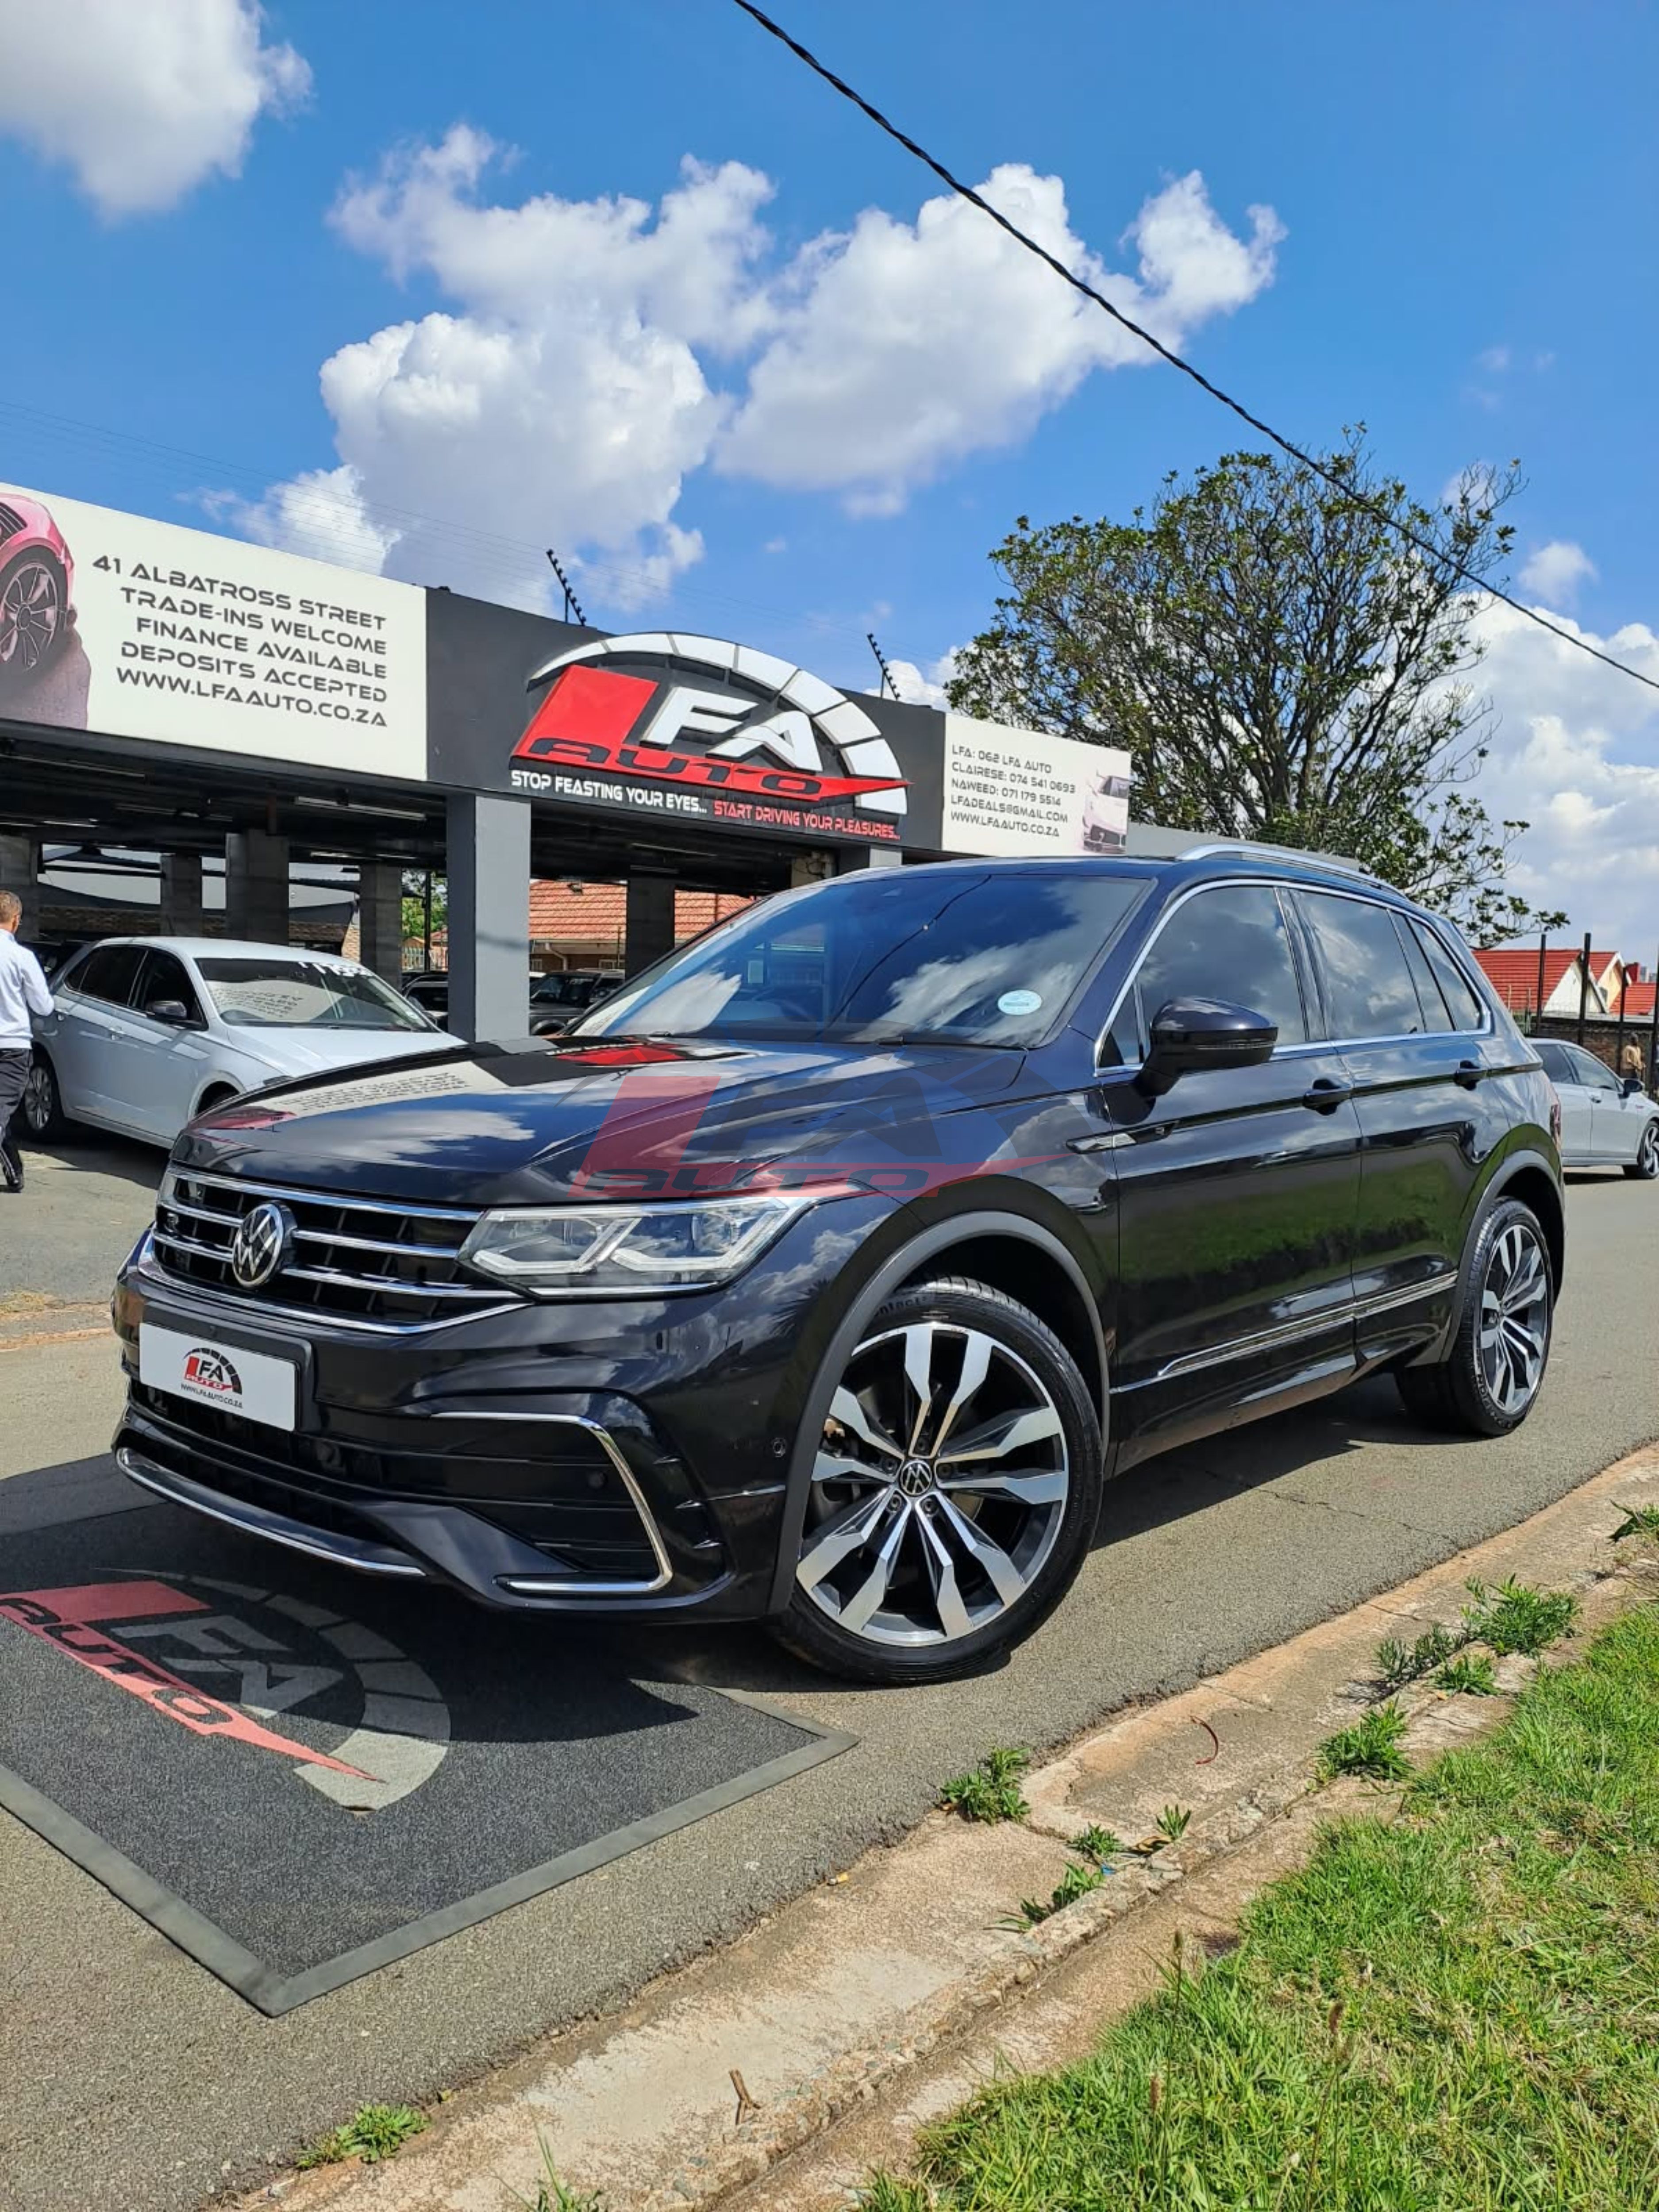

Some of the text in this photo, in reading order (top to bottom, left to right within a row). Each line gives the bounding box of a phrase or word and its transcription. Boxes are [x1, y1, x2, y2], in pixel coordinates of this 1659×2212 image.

[92, 555, 386, 630] 41 ALBATROSS STREET
[120, 587, 386, 655] TRADE-INS WELCOME
[121, 641, 387, 702] DEPOSITS ACCEPTED
[137, 617, 386, 679] FINANCE AVAILABLE
[116, 667, 387, 727] WWW.LFAAUTO.CO.ZA
[527, 738, 822, 795] AUTO
[952, 745, 1051, 773] LFA: 062 LFA AUTO
[952, 762, 1075, 794] CLAIRESE: 074 541 0693
[511, 770, 901, 840] STOP FEASTING YOUR EYES... START DRIVING YOUR PLEASURES...
[951, 795, 1068, 823] LFADEALS@GMAIL.COM
[952, 778, 1061, 806] NAWEED: 071 179 5514
[951, 812, 1059, 837] WWW.LFAAUTO.CO.ZA
